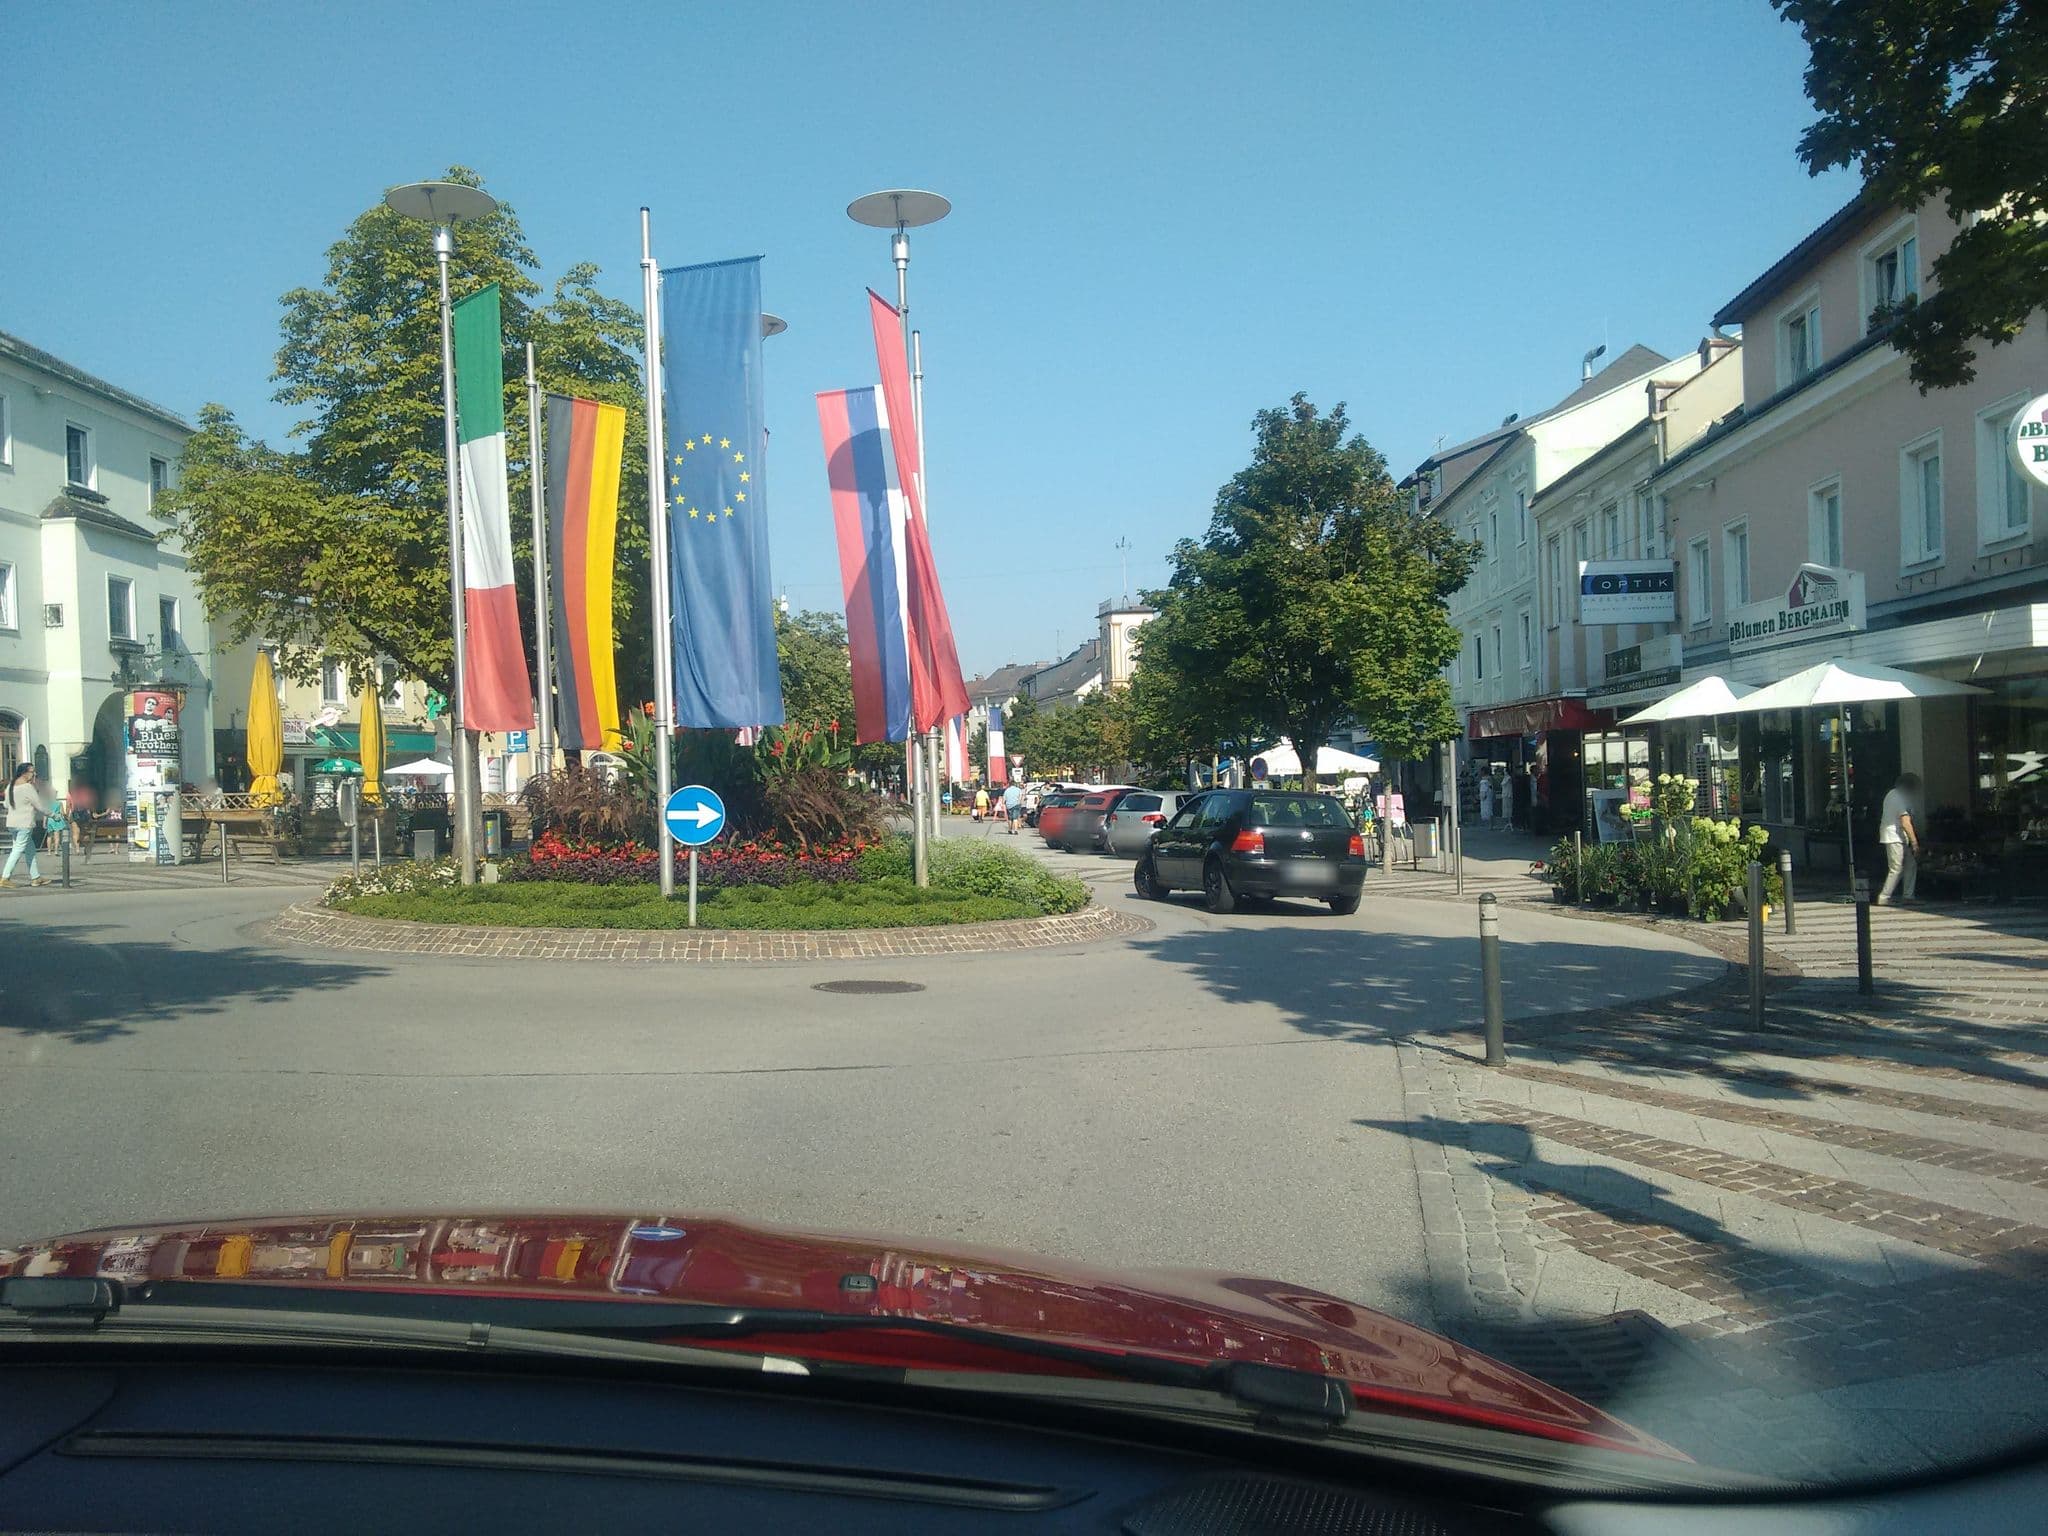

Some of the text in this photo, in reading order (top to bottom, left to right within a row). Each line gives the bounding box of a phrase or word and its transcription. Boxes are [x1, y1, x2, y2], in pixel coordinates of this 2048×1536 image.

[1601, 579, 1668, 589] OPTIK
[1734, 618, 1775, 641] Blumen
[1779, 600, 1844, 630] BERGMAIR
[140, 731, 176, 741] Blues
[510, 731, 522, 746] P
